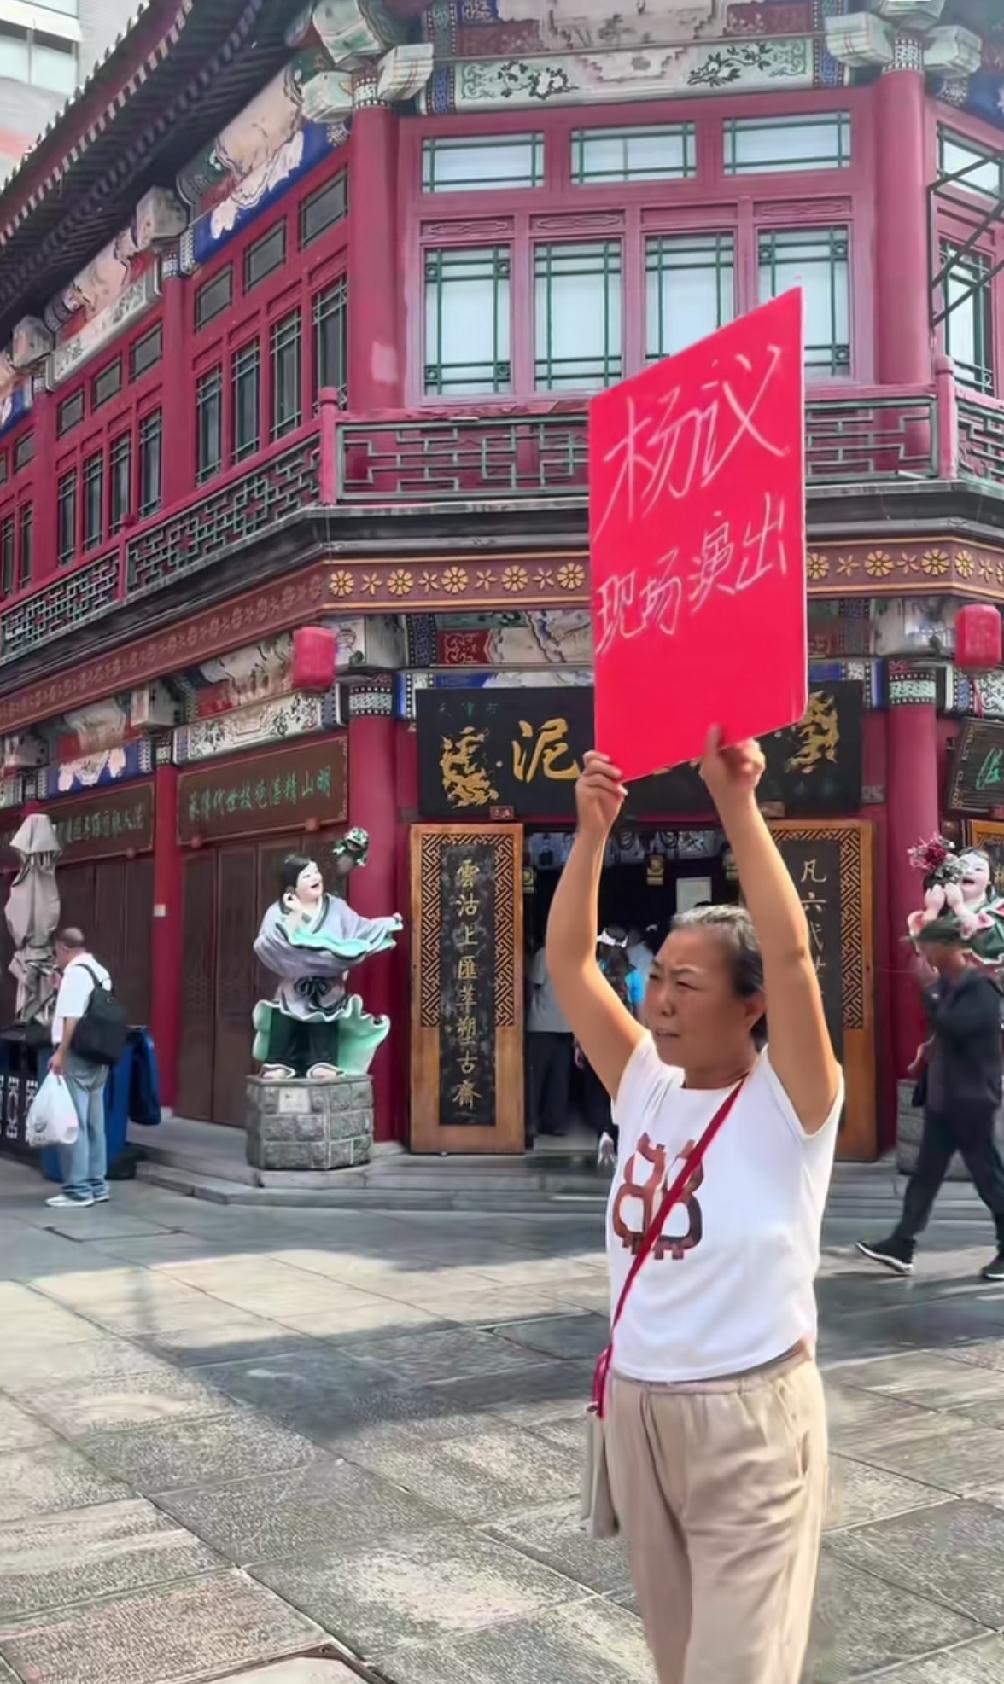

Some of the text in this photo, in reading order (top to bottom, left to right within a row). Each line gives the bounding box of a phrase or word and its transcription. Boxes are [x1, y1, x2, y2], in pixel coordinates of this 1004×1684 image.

[593, 343, 790, 544] 杨议
[594, 492, 787, 656] 现场演出
